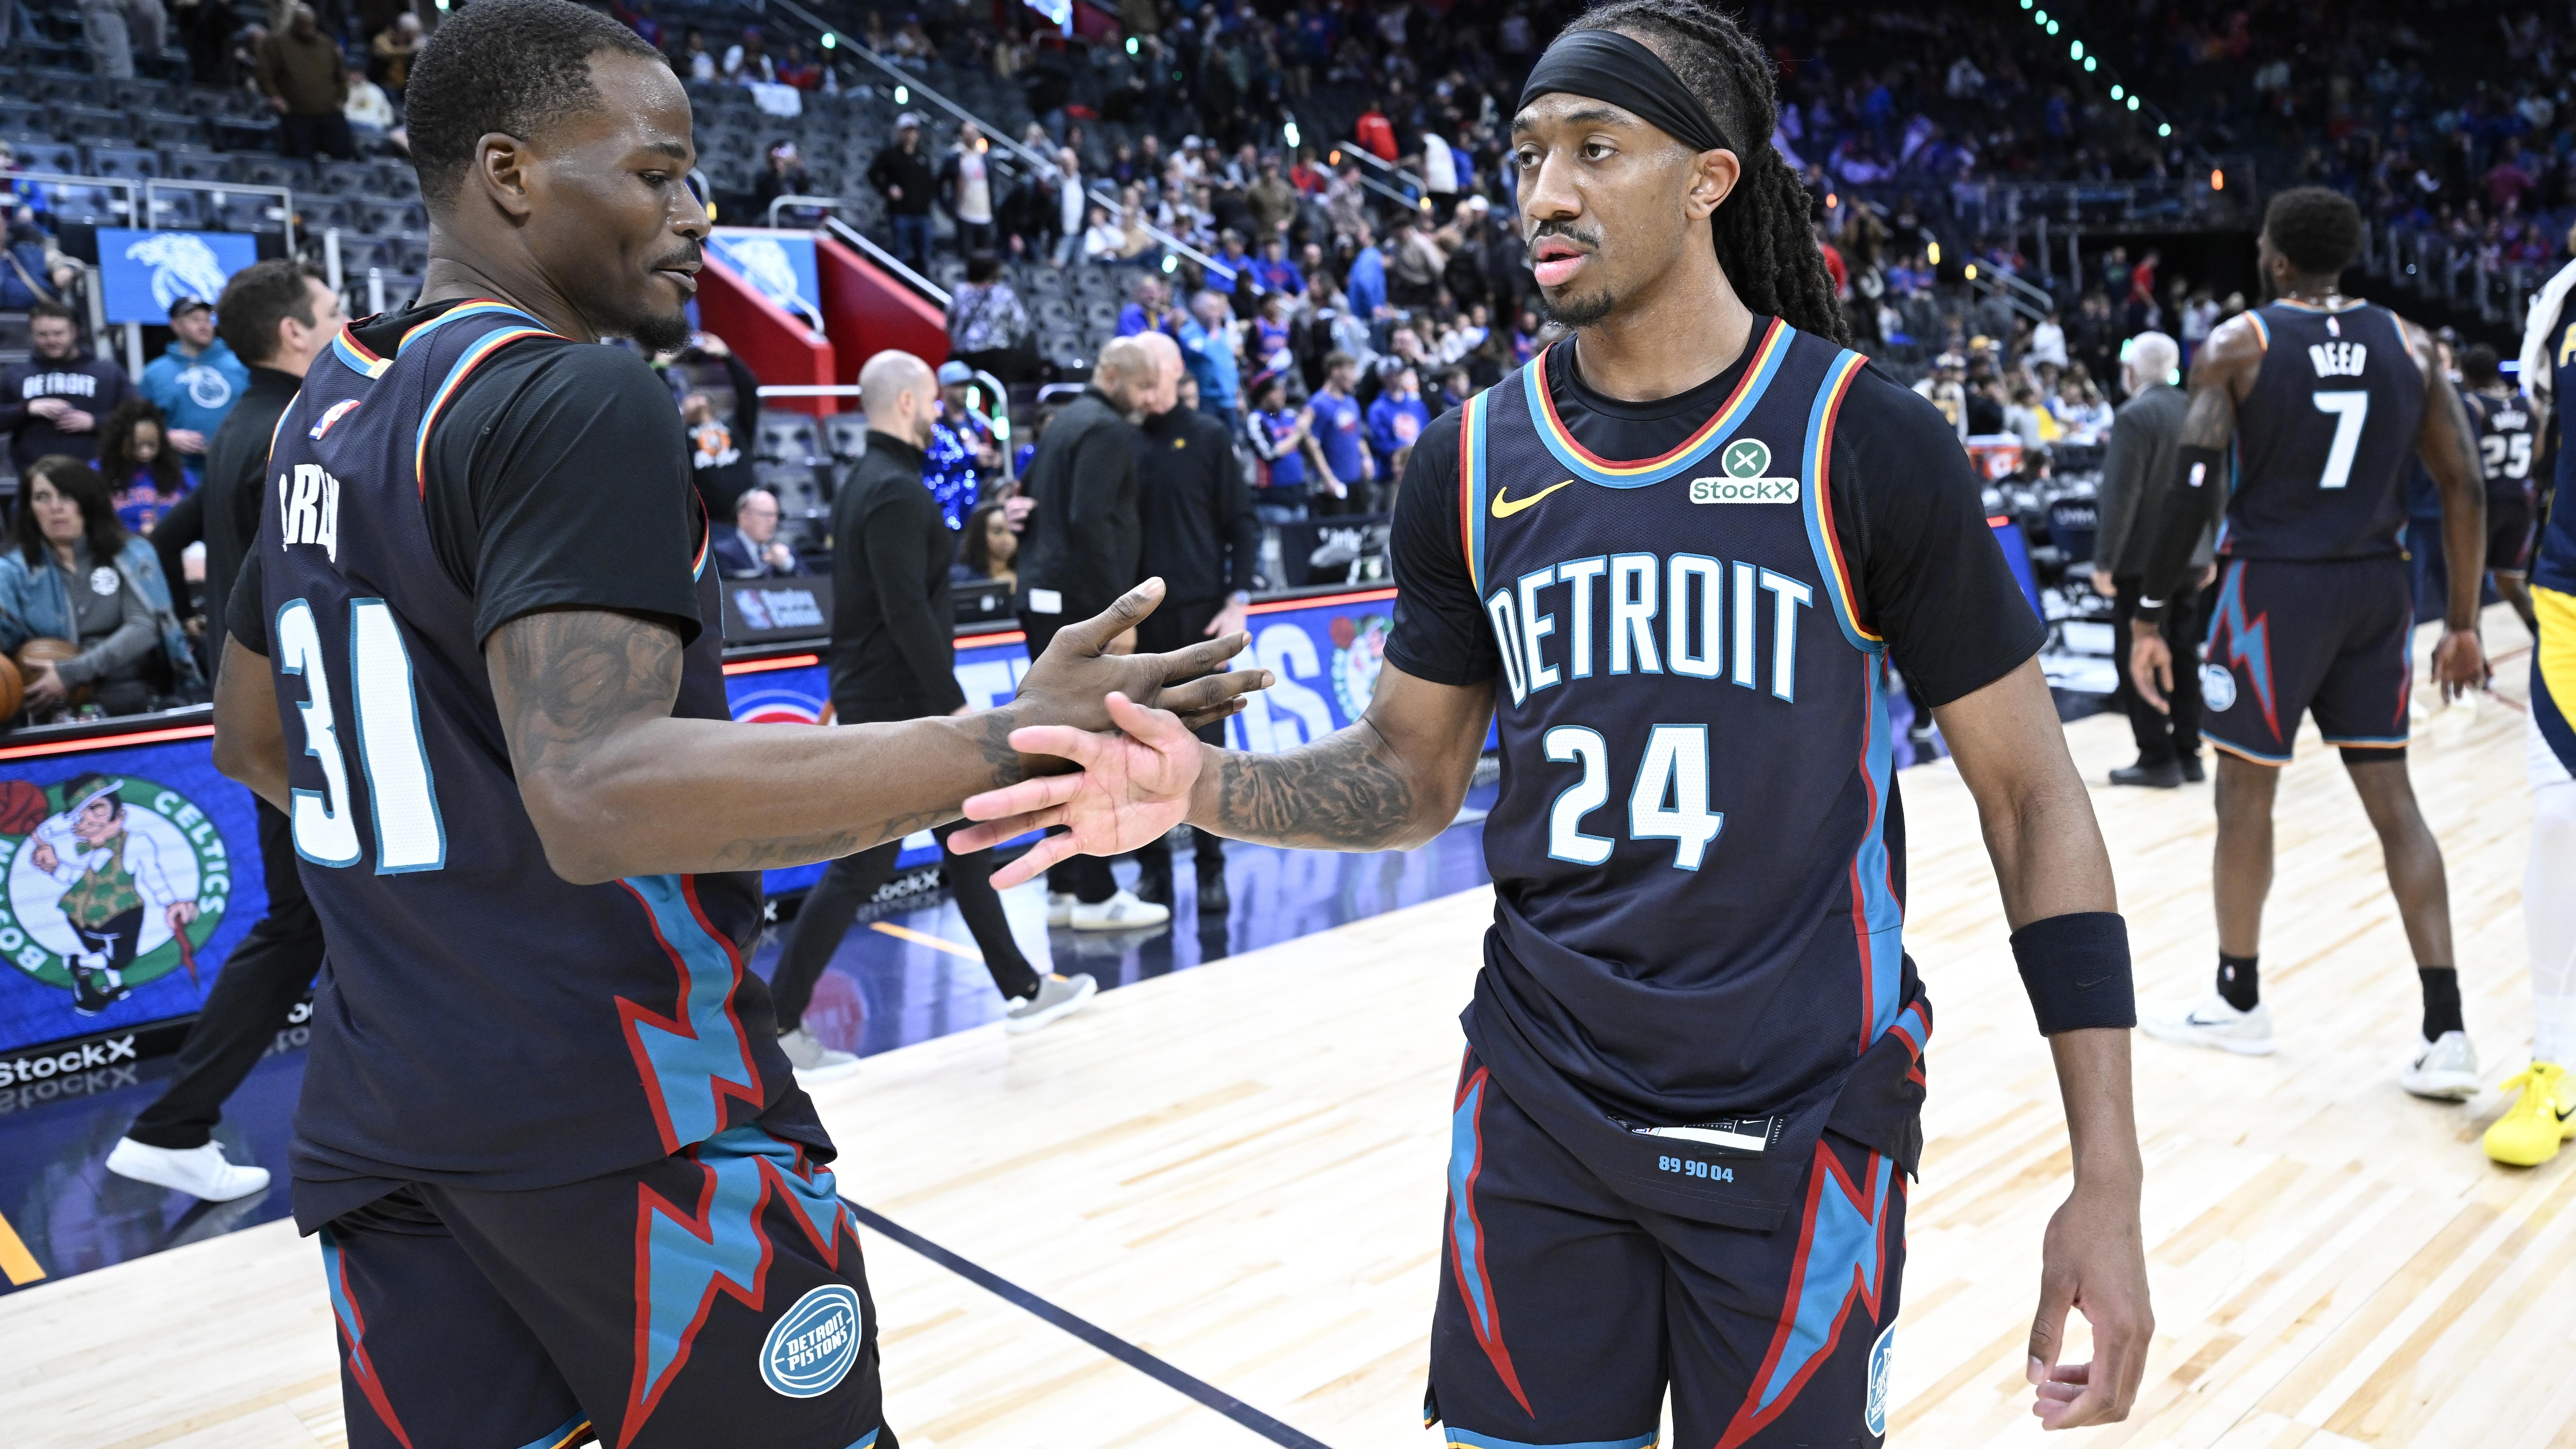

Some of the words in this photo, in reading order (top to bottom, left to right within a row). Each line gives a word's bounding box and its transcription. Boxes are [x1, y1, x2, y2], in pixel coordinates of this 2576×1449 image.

[2308, 341, 2367, 378] REED
[2312, 390, 2368, 489] 7
[2480, 433, 2533, 479] 25
[1693, 481, 1793, 500] StockX
[1485, 551, 1813, 710] DETROIT
[276, 597, 447, 875] 31
[1542, 723, 1724, 871] 24
[154, 790, 230, 914] CELTICS
[0, 1033, 137, 1088] StockX
[1658, 1155, 1681, 1173] 89
[1685, 1160, 1707, 1178] 90
[1710, 1165, 1734, 1183] 04
[786, 1310, 844, 1355] DETROIT
[787, 1325, 848, 1372] PISTONS
